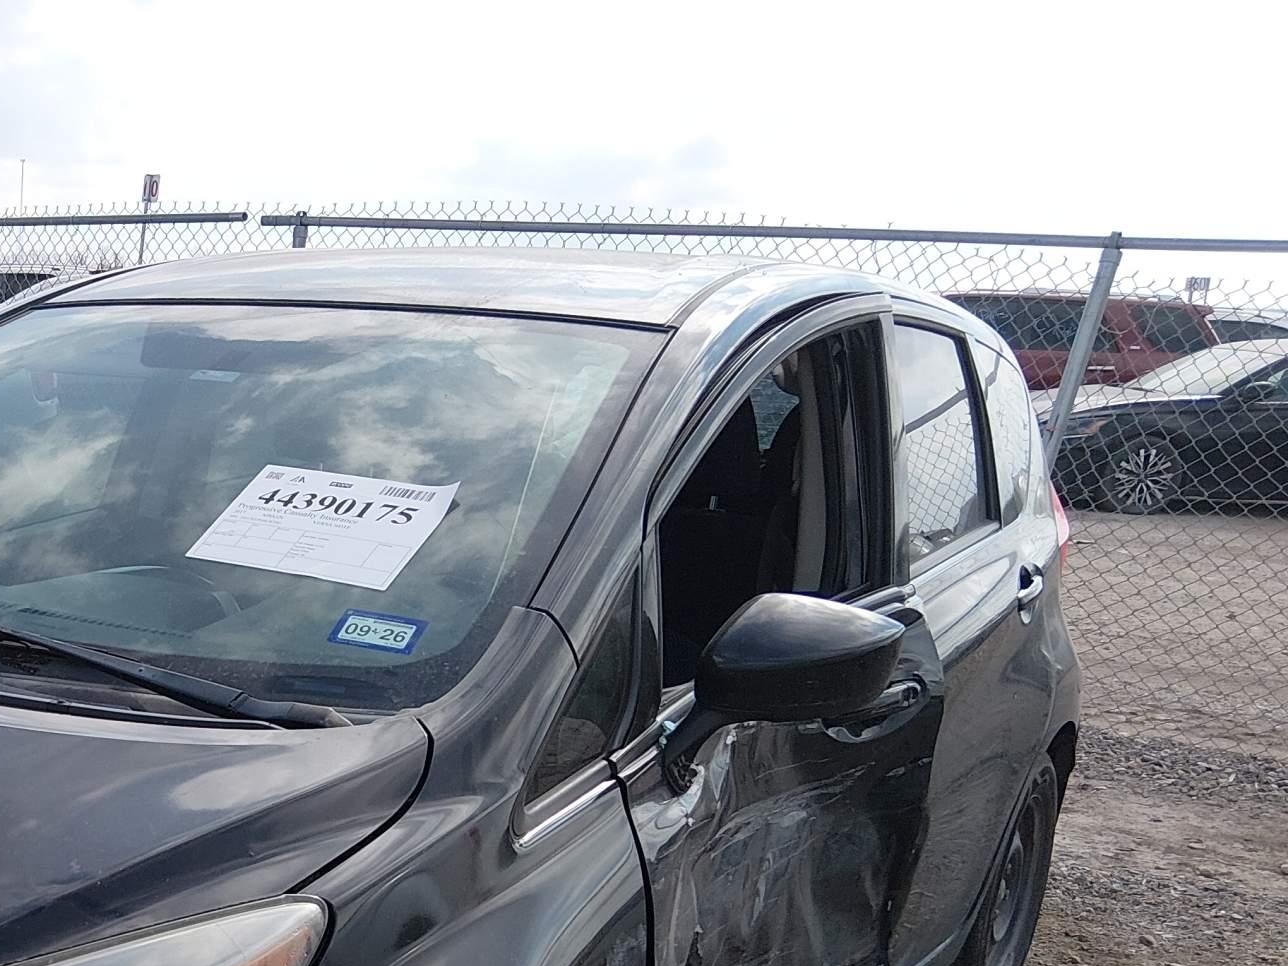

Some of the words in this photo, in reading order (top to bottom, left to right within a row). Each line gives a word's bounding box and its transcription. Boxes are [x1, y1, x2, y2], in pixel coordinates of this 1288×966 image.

[258, 488, 420, 525] 44390175
[344, 622, 371, 637] 09
[379, 628, 408, 643] 26
